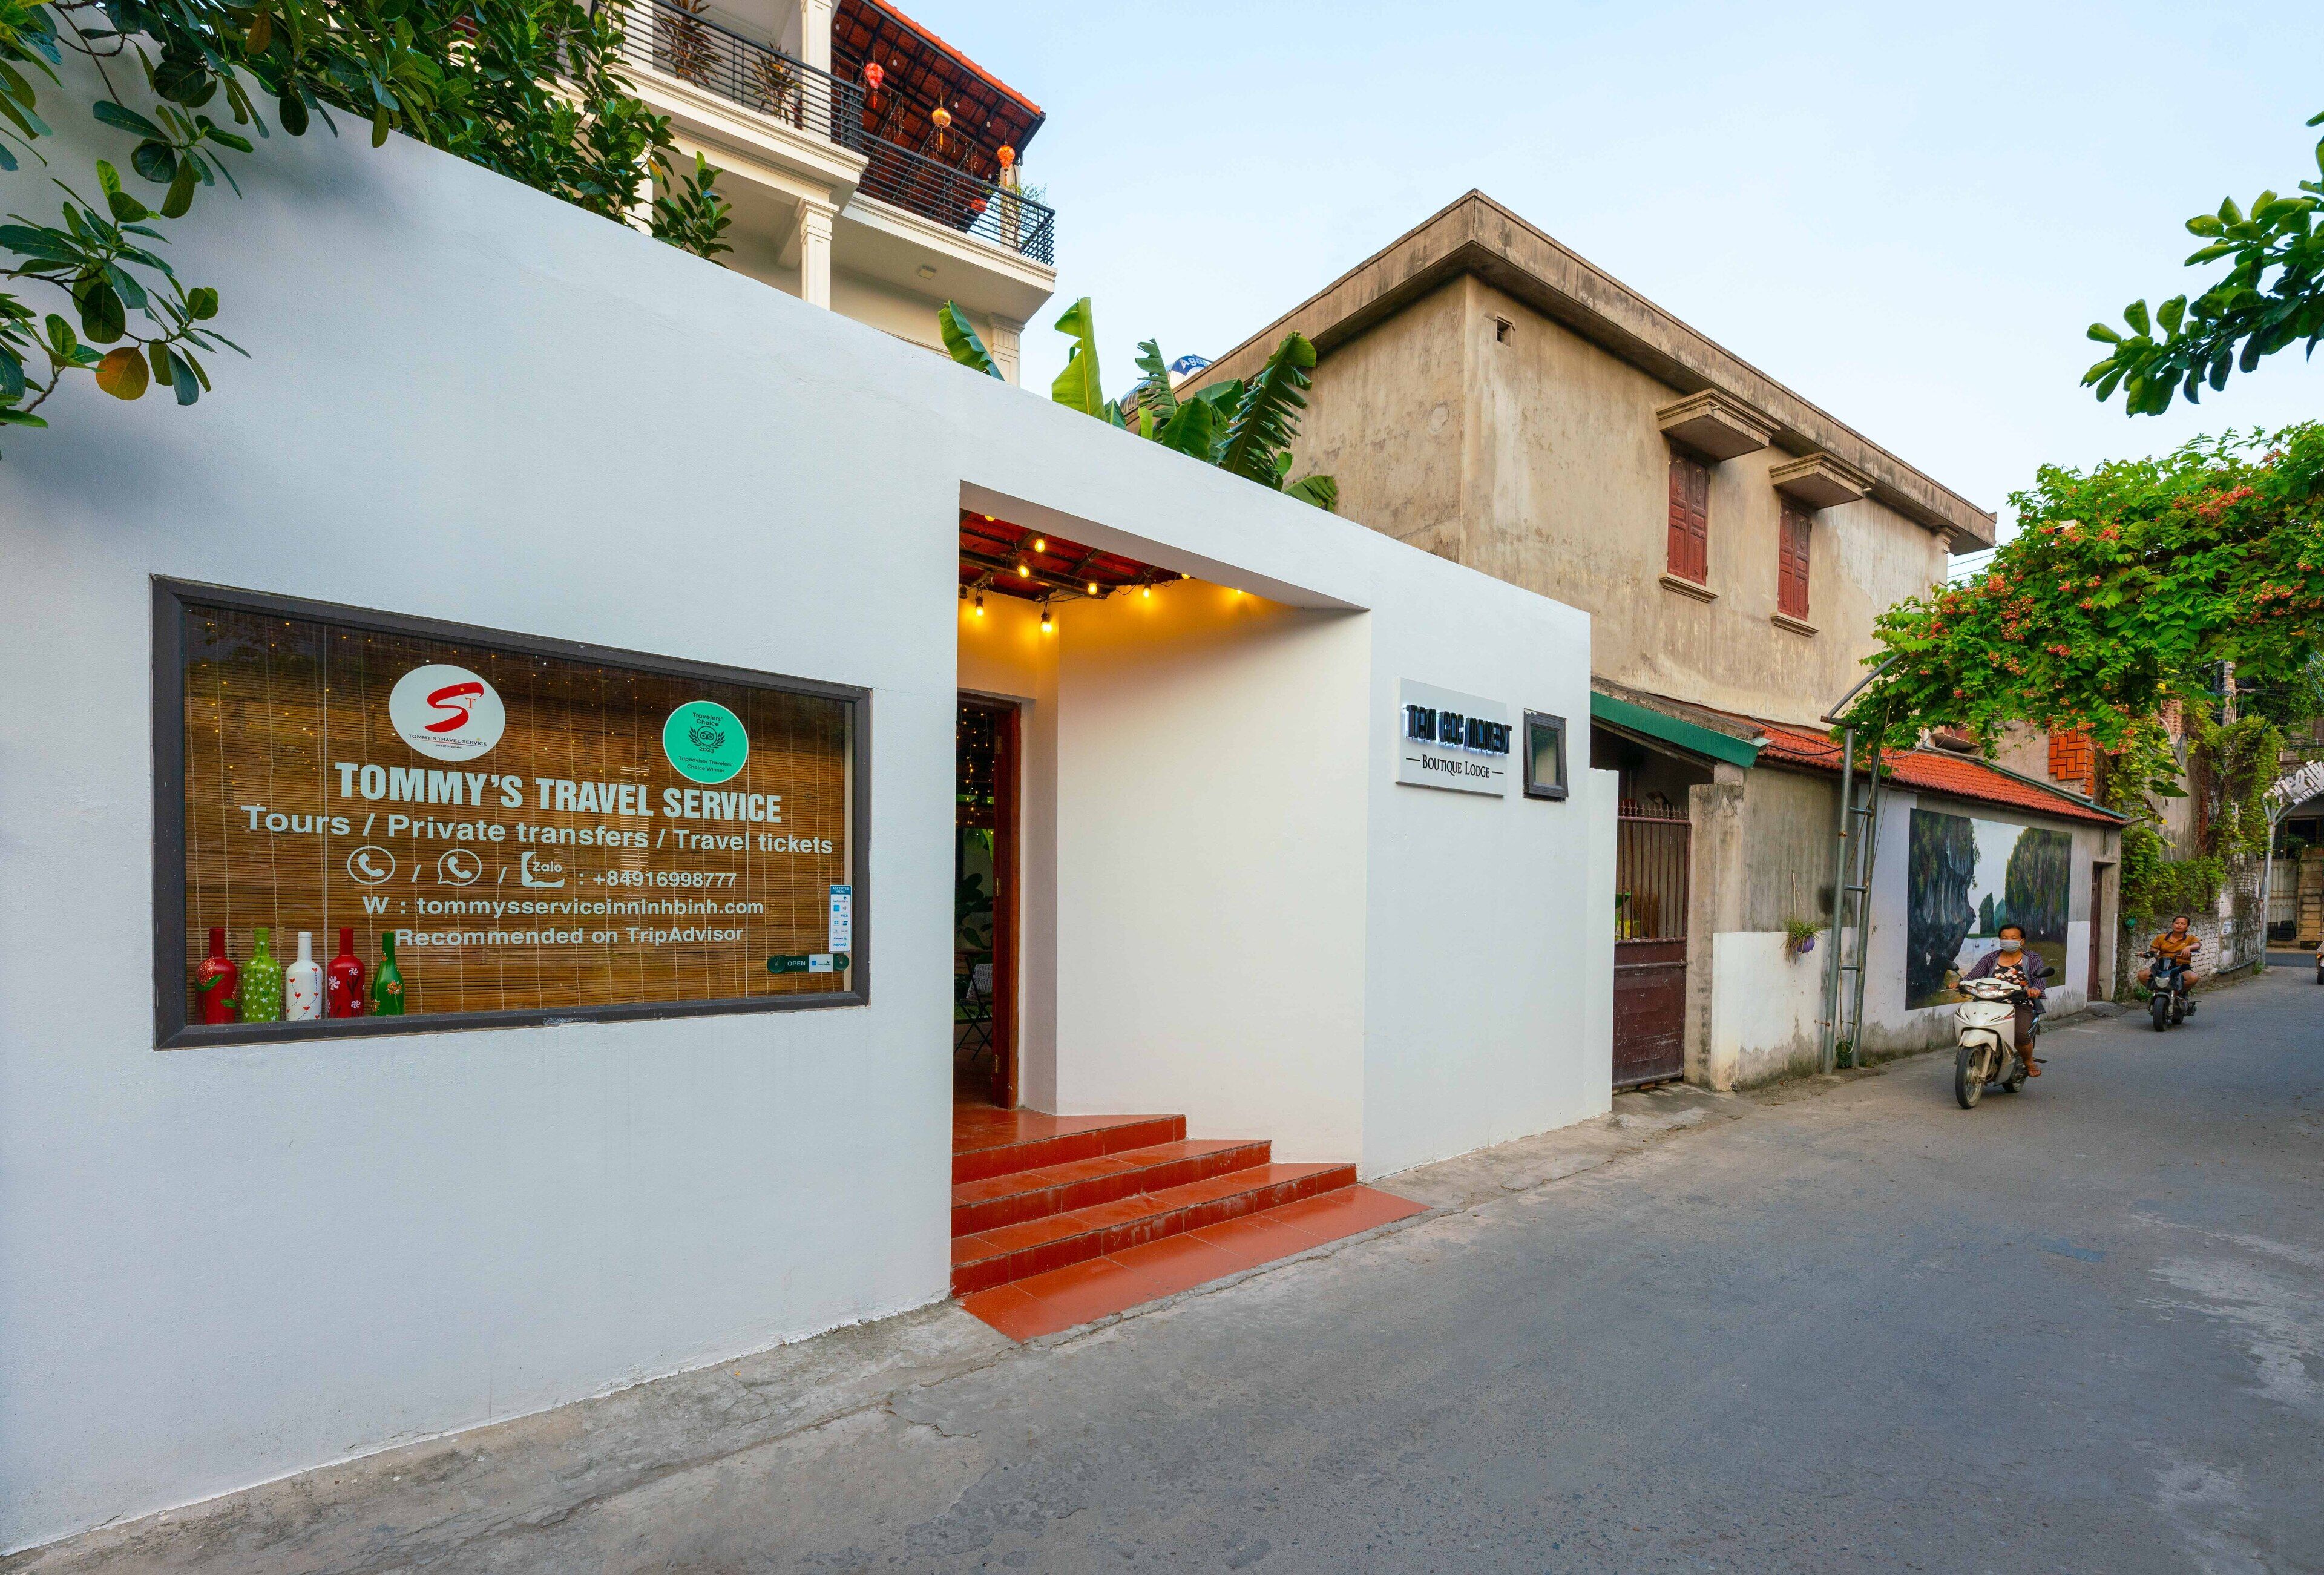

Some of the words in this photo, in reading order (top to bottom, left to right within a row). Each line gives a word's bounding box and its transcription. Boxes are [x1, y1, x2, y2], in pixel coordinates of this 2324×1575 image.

[693, 712, 723, 722] Travelers'
[678, 755, 708, 764] Tripadvisor
[335, 762, 523, 808] TOMMY'S
[535, 778, 654, 817] TRAVEL
[663, 787, 782, 823] SERVICE
[241, 805, 350, 836] Tours
[388, 814, 505, 842] Private
[517, 821, 649, 848] transfers
[673, 829, 750, 851] Travel
[758, 833, 833, 854] tickets
[532, 861, 563, 873] Zalo
[592, 870, 737, 887] +84916998777
[363, 896, 390, 915] W
[418, 898, 764, 919] tommysserviceinninhbinh.com
[395, 927, 583, 947] Recommended
[592, 932, 619, 944] on
[626, 926, 744, 947] TripAdvisor
